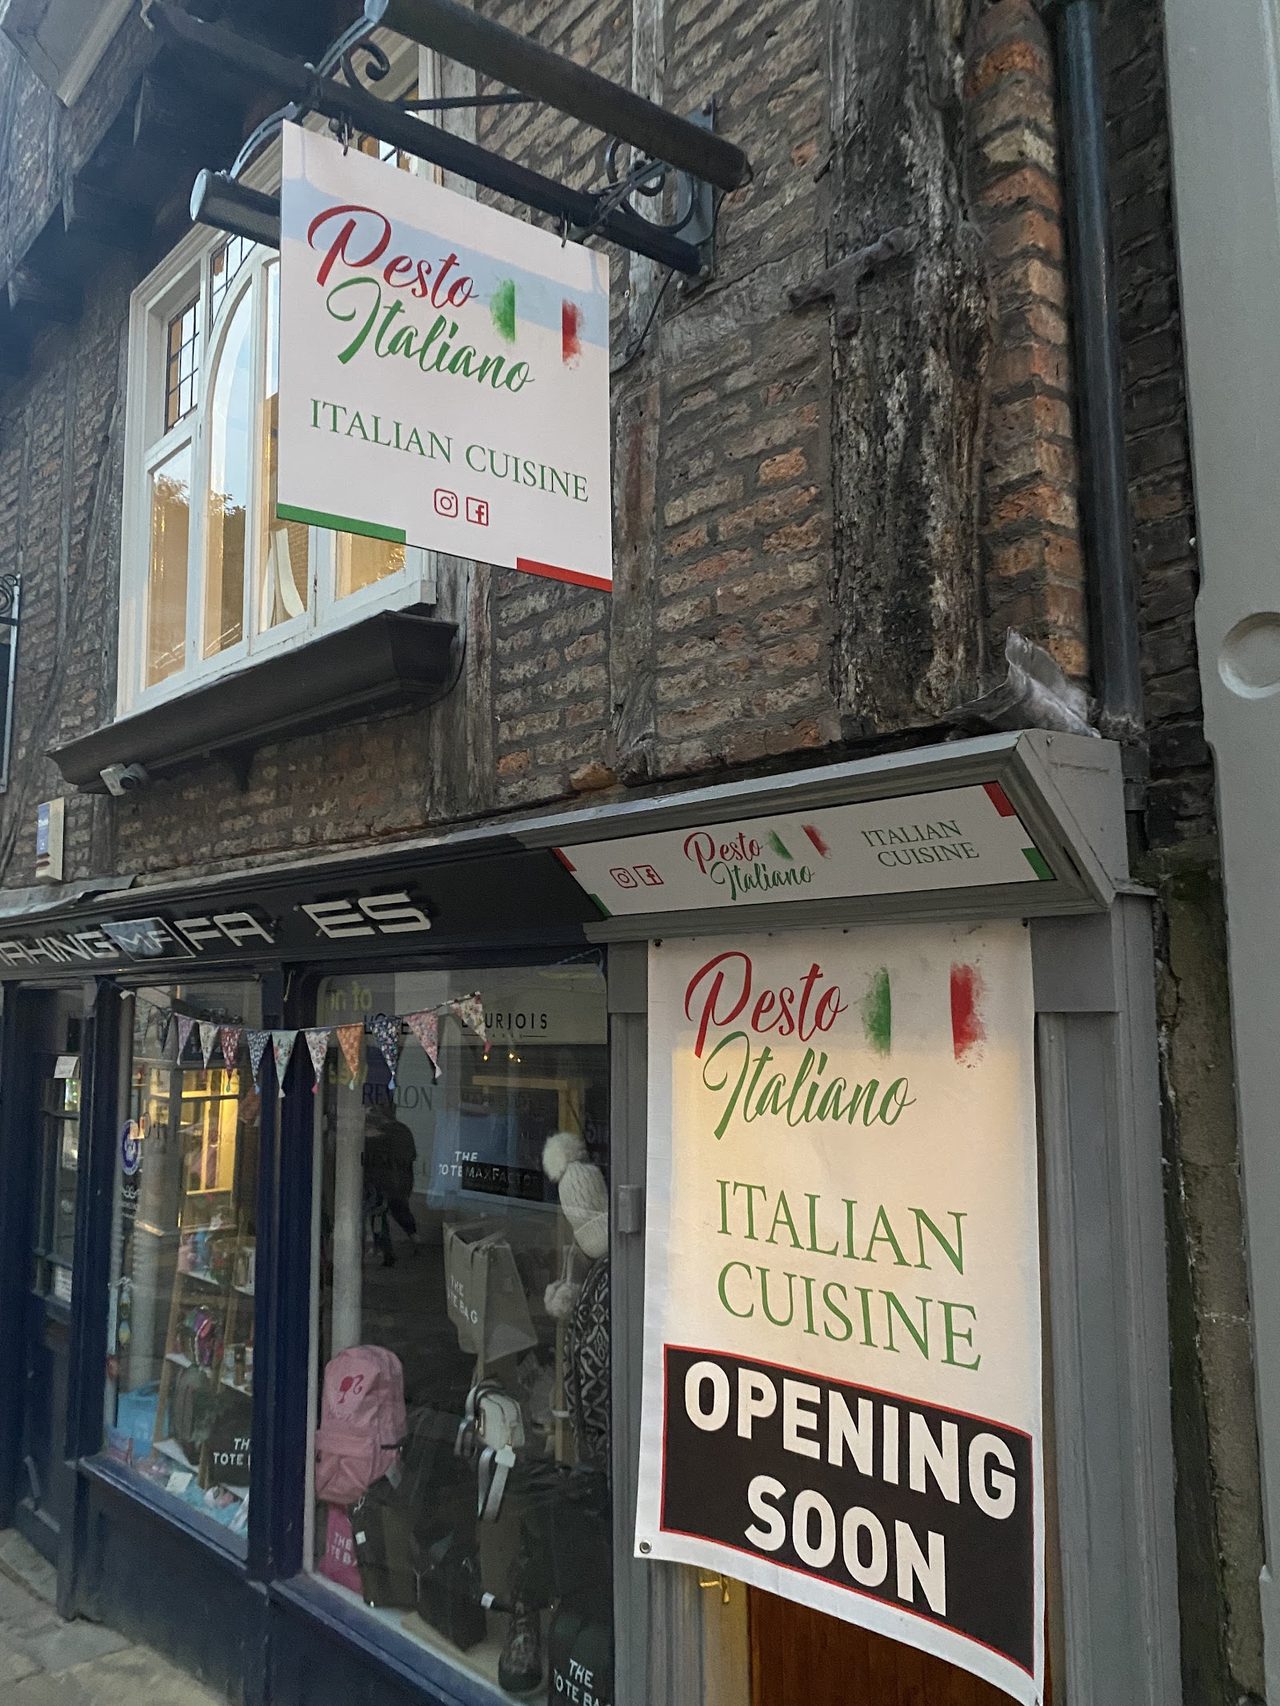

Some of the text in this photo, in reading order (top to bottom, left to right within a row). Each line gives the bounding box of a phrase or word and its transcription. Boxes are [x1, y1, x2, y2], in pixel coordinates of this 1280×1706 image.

[307, 204, 480, 309] Pesto
[325, 276, 536, 393] Italiano
[310, 397, 590, 503] ITALIAN CUISINE
[683, 831, 764, 875] Pesto
[861, 819, 963, 848] ITALIAN
[877, 842, 980, 868] CUISINE
[710, 860, 816, 901] Italiano
[461, 1012, 548, 1030] URJOIS
[684, 951, 849, 1059] Pesto
[702, 1031, 917, 1140] Italiano
[454, 1150, 479, 1162] THE
[715, 1178, 968, 1276] ITALIAN
[717, 1260, 982, 1371] CUISINE
[213, 1451, 244, 1466] TOTE
[234, 1437, 251, 1451] TH
[684, 1360, 1017, 1520] OPENING
[744, 1474, 947, 1617] SOON
[568, 1657, 594, 1690] THE
